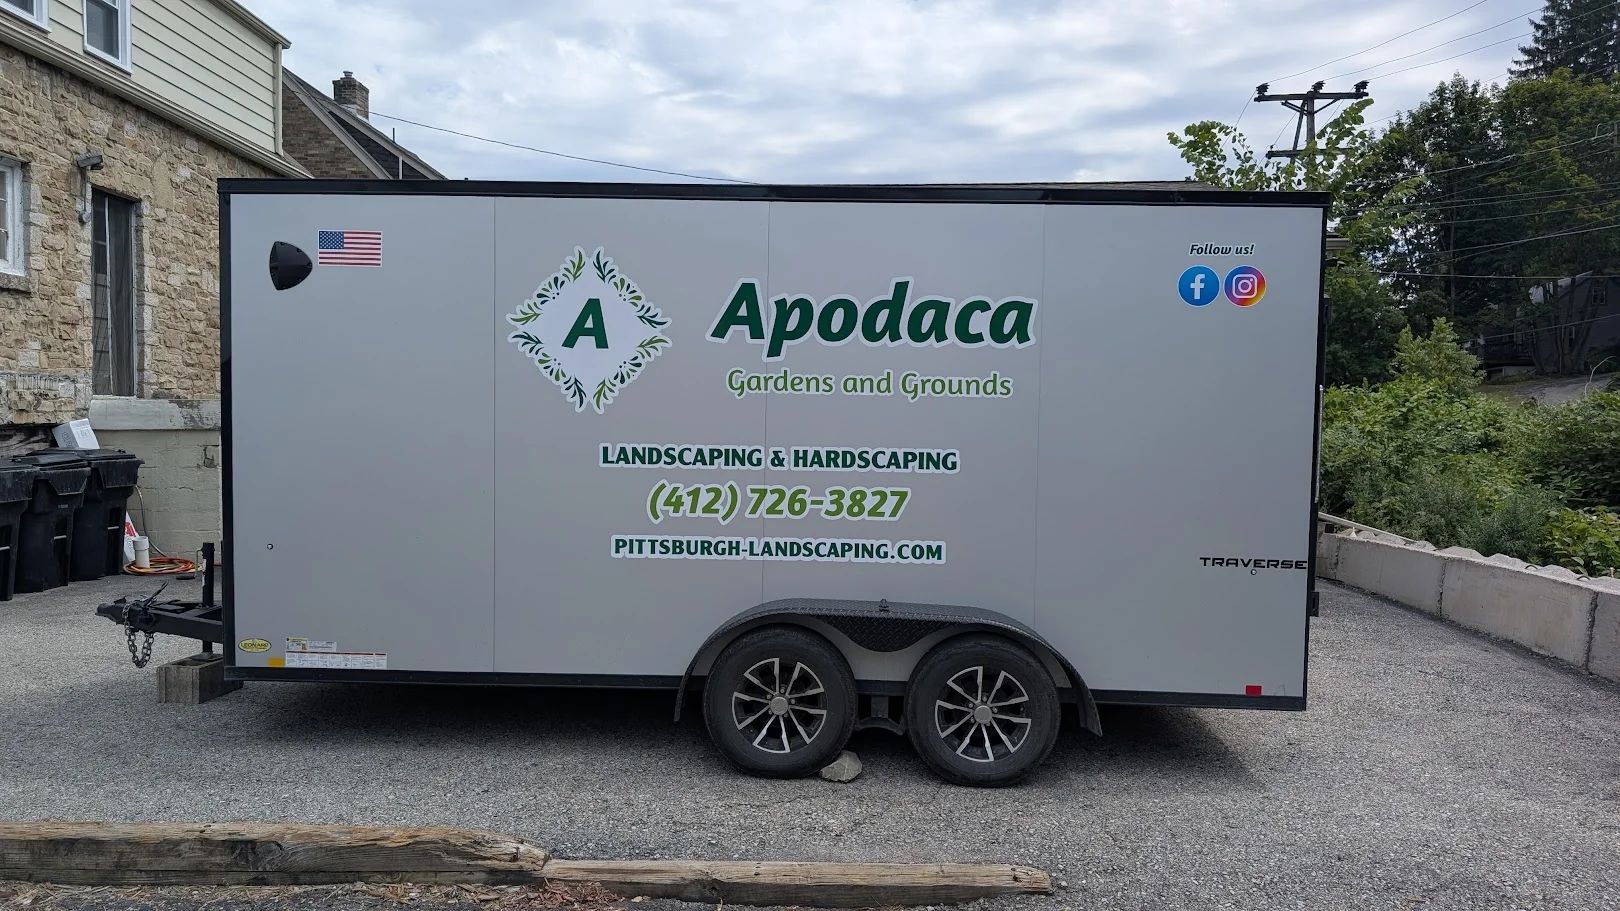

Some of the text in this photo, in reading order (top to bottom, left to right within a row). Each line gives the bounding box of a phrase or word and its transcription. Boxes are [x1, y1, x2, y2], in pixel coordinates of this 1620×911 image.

[1190, 243, 1255, 255] Follow us!
[561, 297, 610, 350] A
[710, 280, 1035, 358] Apodaca
[727, 369, 1012, 399] Gardens and Grounds
[601, 446, 959, 471] LANDSCAPING & HARDSCAPING
[649, 482, 910, 522] (412) 726-3827
[613, 538, 943, 561] PITTSBURGH-LANDSCAPING.COM
[1199, 557, 1308, 570] TRAVERSE
